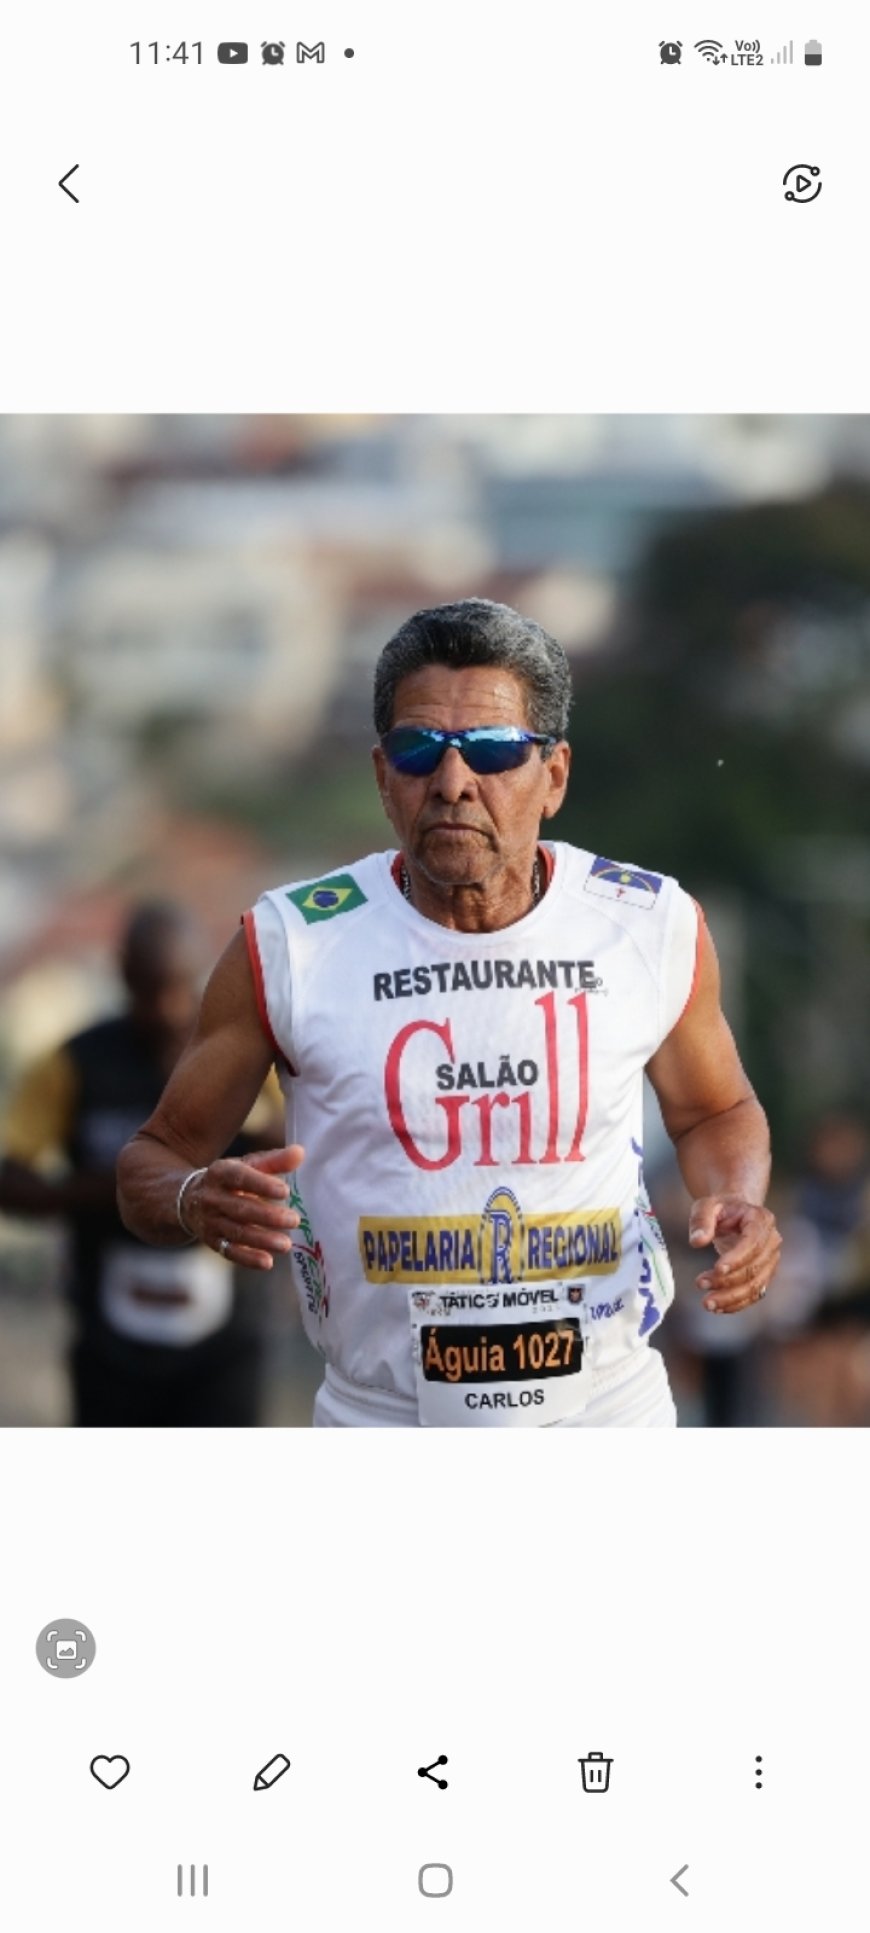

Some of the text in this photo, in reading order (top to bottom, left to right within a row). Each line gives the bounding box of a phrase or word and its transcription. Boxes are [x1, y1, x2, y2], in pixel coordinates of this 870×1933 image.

[373, 959, 597, 1001] RESTAURANTE
[384, 991, 590, 1172] Grill
[435, 1055, 539, 1091] SALÃO
[363, 1229, 476, 1273] PAPELARIA
[527, 1222, 619, 1270] REGIONAL
[502, 1287, 559, 1308] MÓVEL
[425, 1328, 575, 1382] Águia 1027
[464, 1388, 545, 1410] CARLOS
